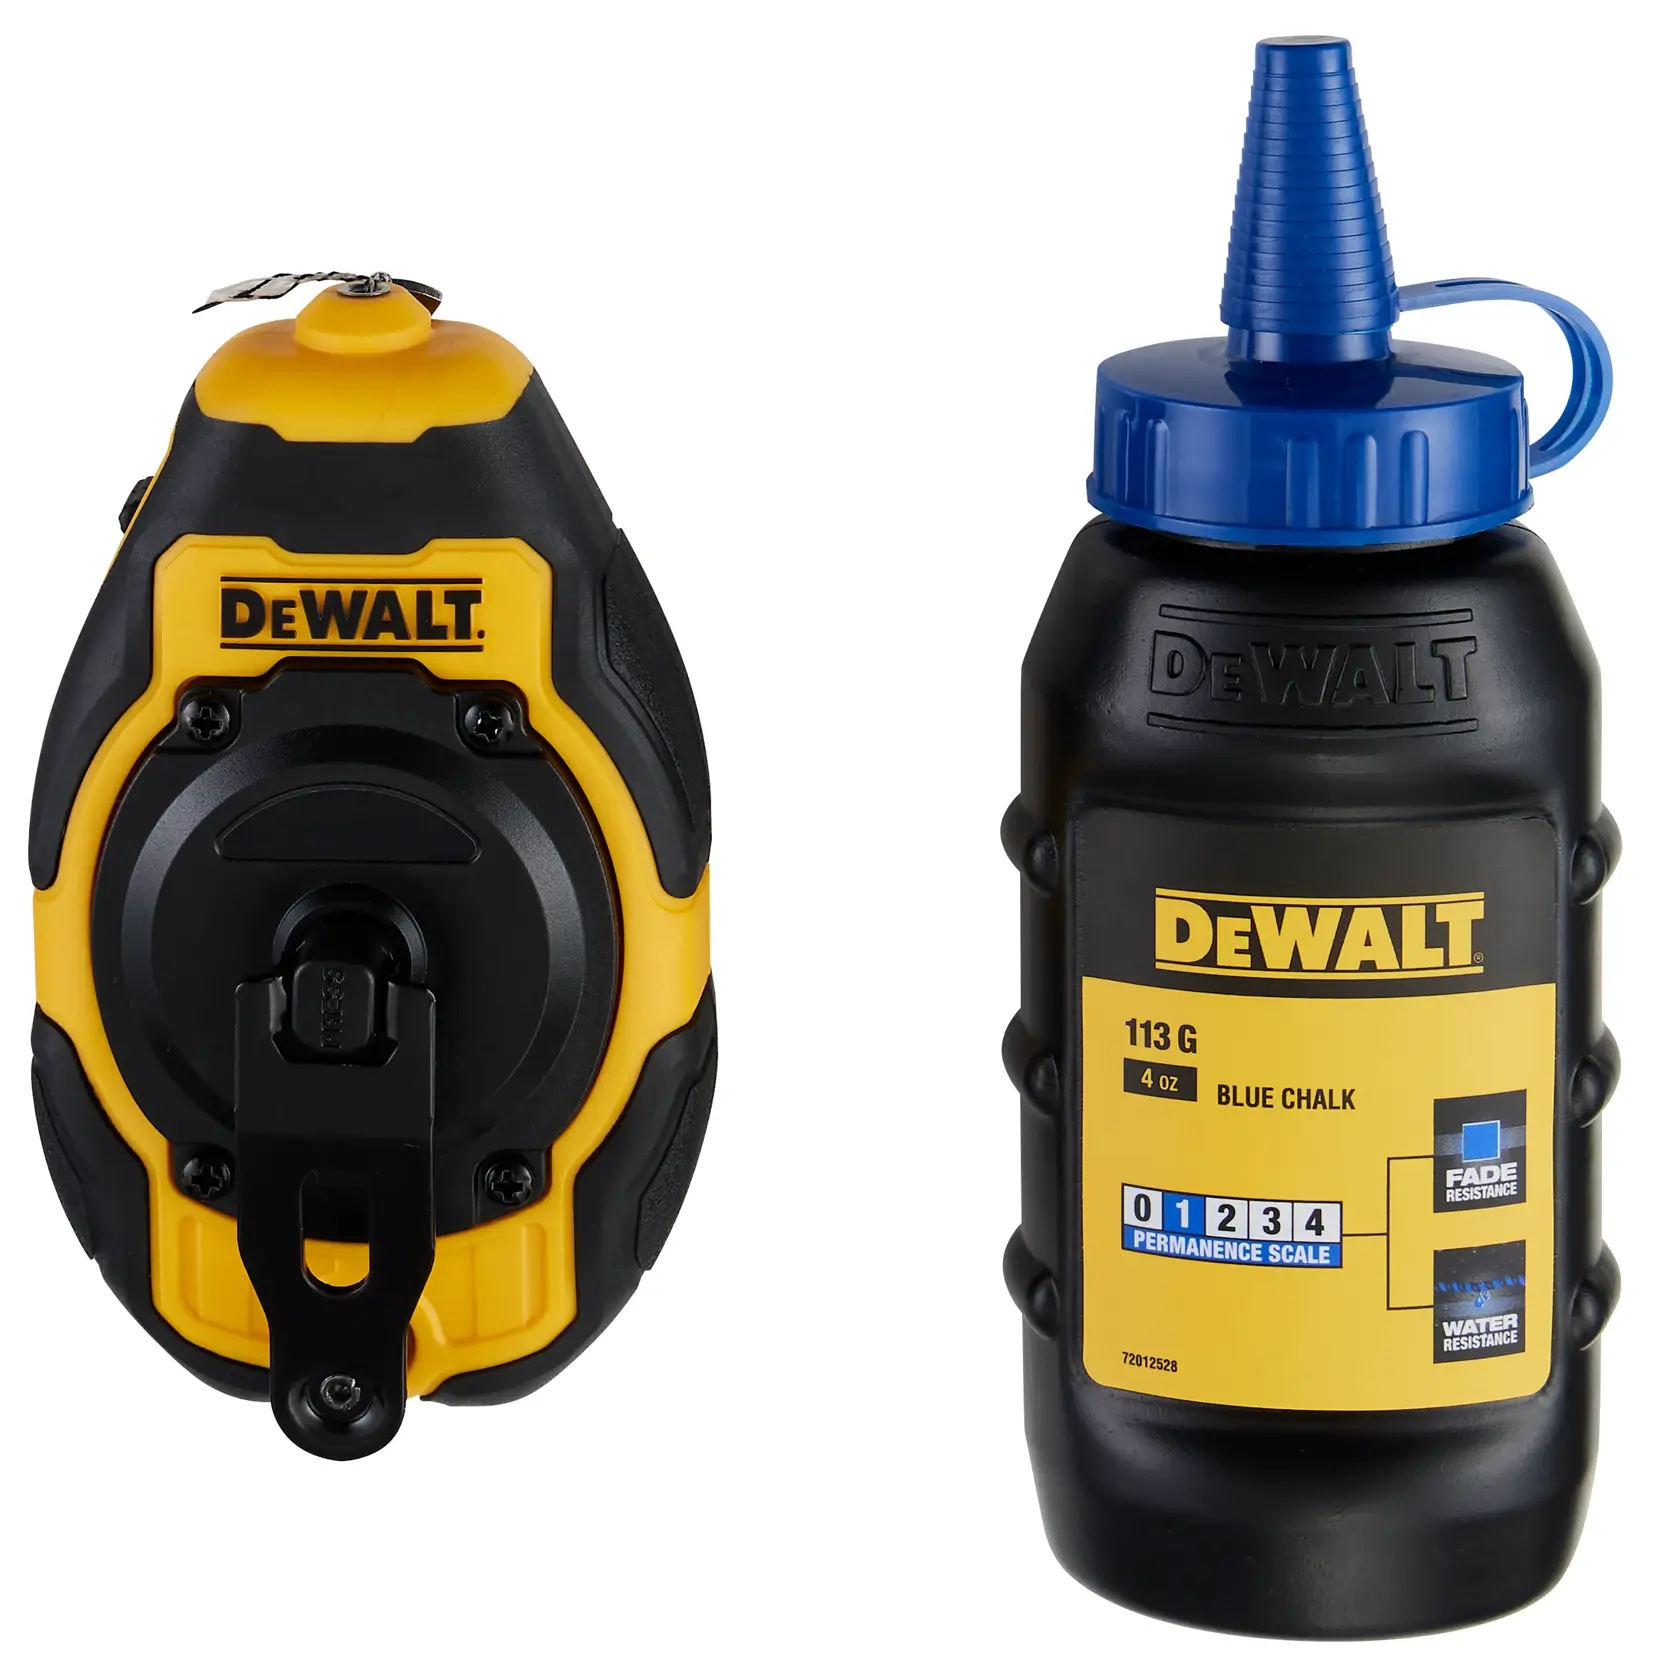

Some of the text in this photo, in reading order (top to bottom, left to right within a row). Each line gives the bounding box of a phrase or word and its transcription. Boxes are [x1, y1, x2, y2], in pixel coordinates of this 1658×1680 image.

[1150, 629, 1477, 707] DEWALT
[320, 966, 345, 1048] PRESS
[1125, 1018, 1197, 1054] 113 G
[1141, 1067, 1154, 1089] 4
[1217, 1084, 1356, 1110] BLUE CHALK
[1446, 1162, 1518, 1188] FADE
[1446, 1182, 1518, 1203] RESISTANCE
[1134, 1193, 1325, 1237] 0 1 2 3 4
[1133, 1230, 1331, 1265] PERMANENCE SCALE
[1442, 1313, 1518, 1337] WATER
[1443, 1330, 1518, 1352] RESISTANCE
[1122, 1351, 1178, 1373] 72012528
